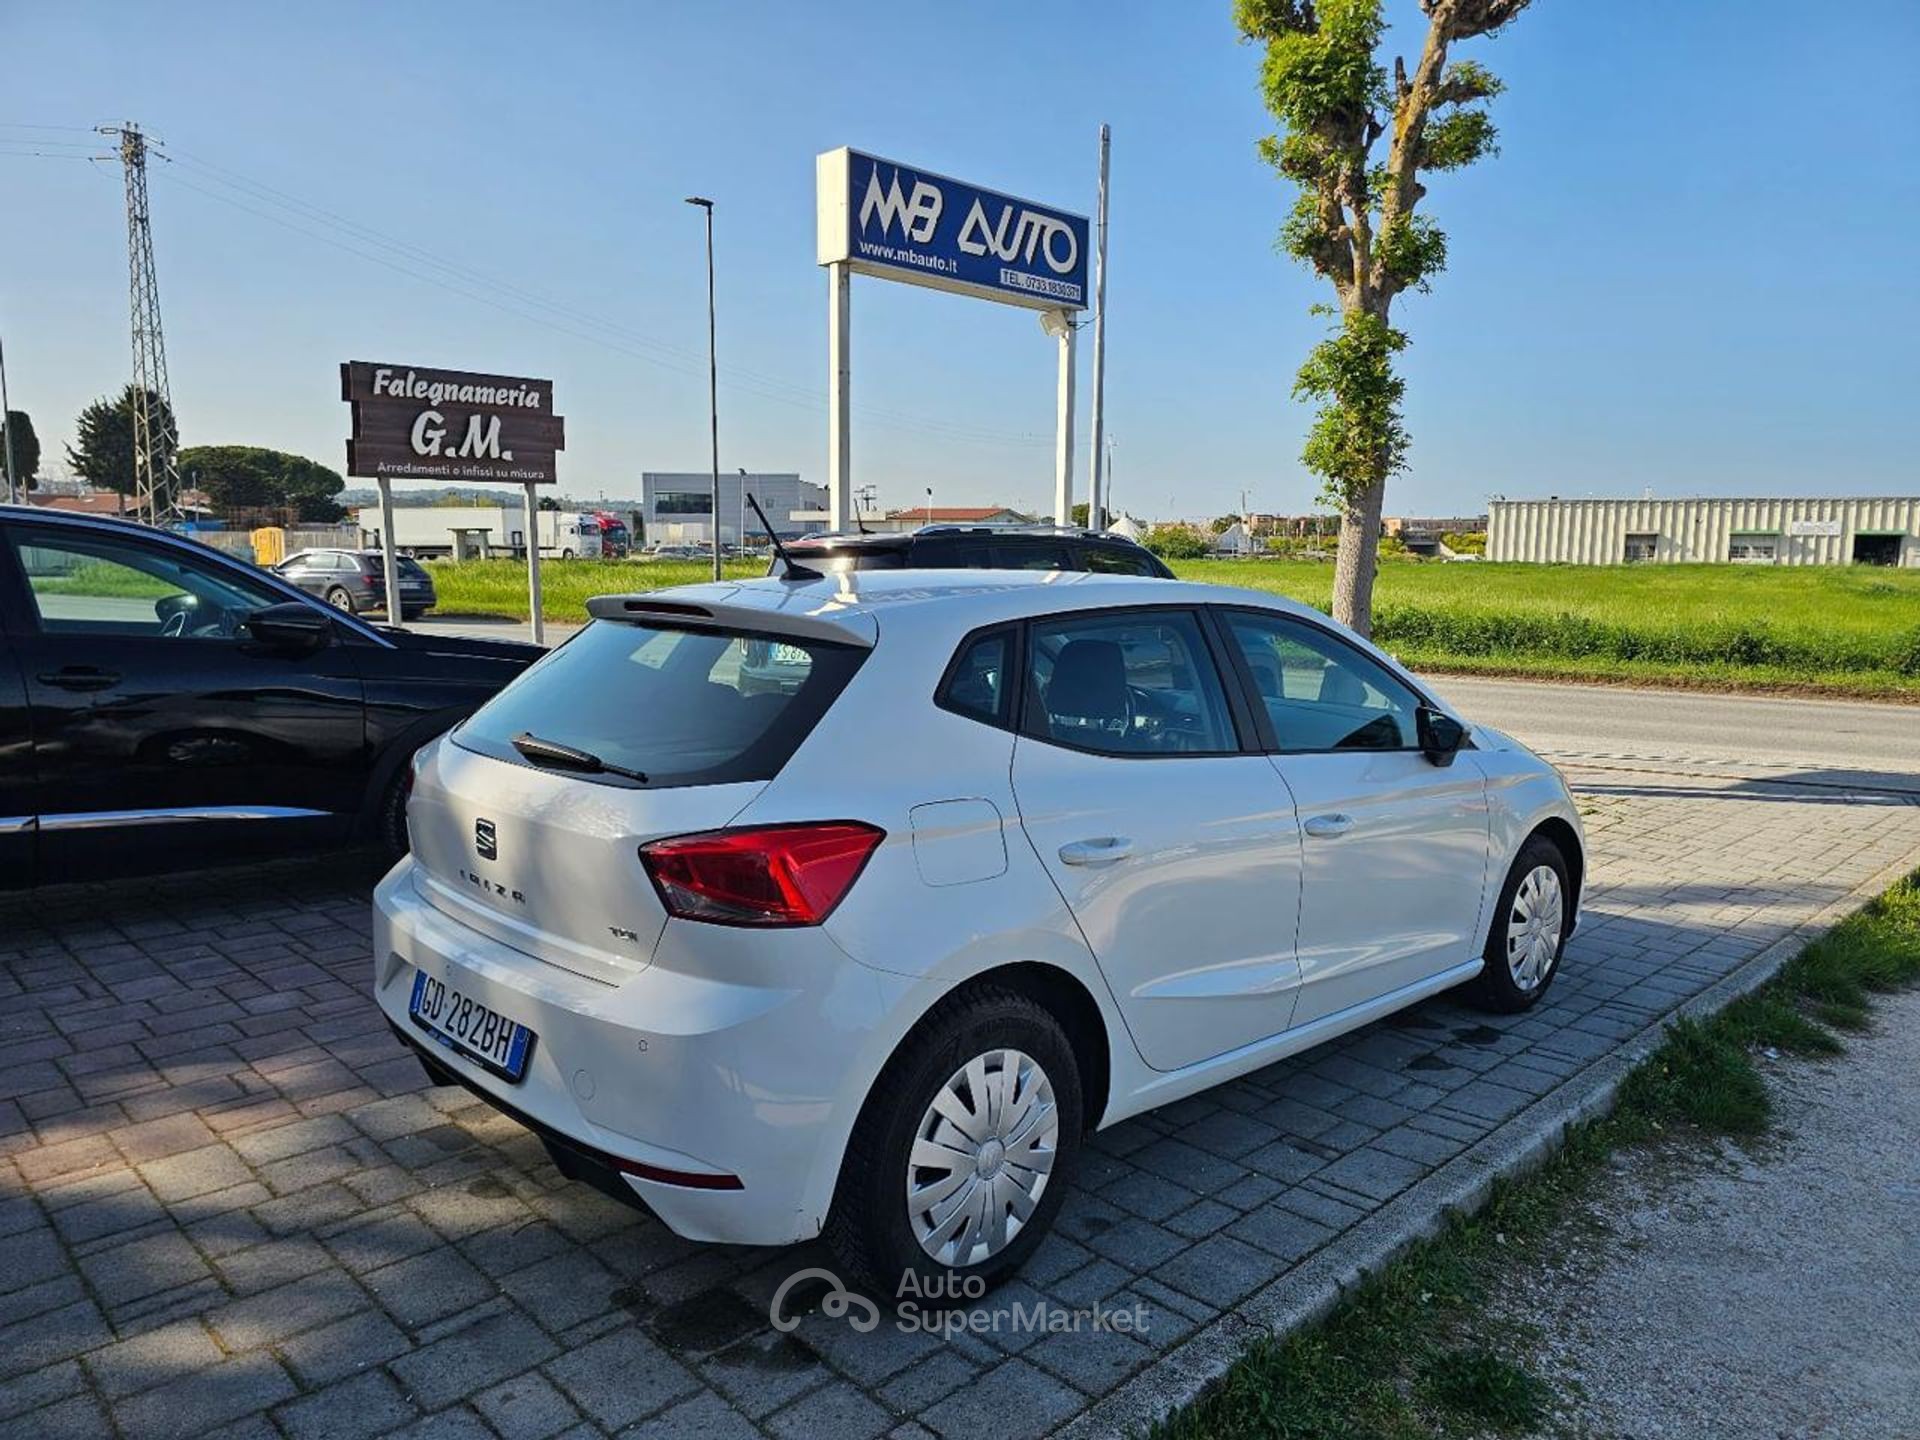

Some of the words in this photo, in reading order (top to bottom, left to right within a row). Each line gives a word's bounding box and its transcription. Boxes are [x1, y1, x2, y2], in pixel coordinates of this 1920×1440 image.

[859, 161, 943, 243] MB
[957, 197, 1078, 273] AUTO
[859, 241, 958, 274] www.mbauto.it
[1003, 271, 1024, 287] TEL.
[373, 369, 540, 407] Falegnameria
[411, 410, 513, 461] G.M.
[377, 462, 450, 476] Arredamenti
[462, 465, 494, 477] infissi
[510, 470, 545, 479] misura
[444, 991, 515, 1062] 282BH
